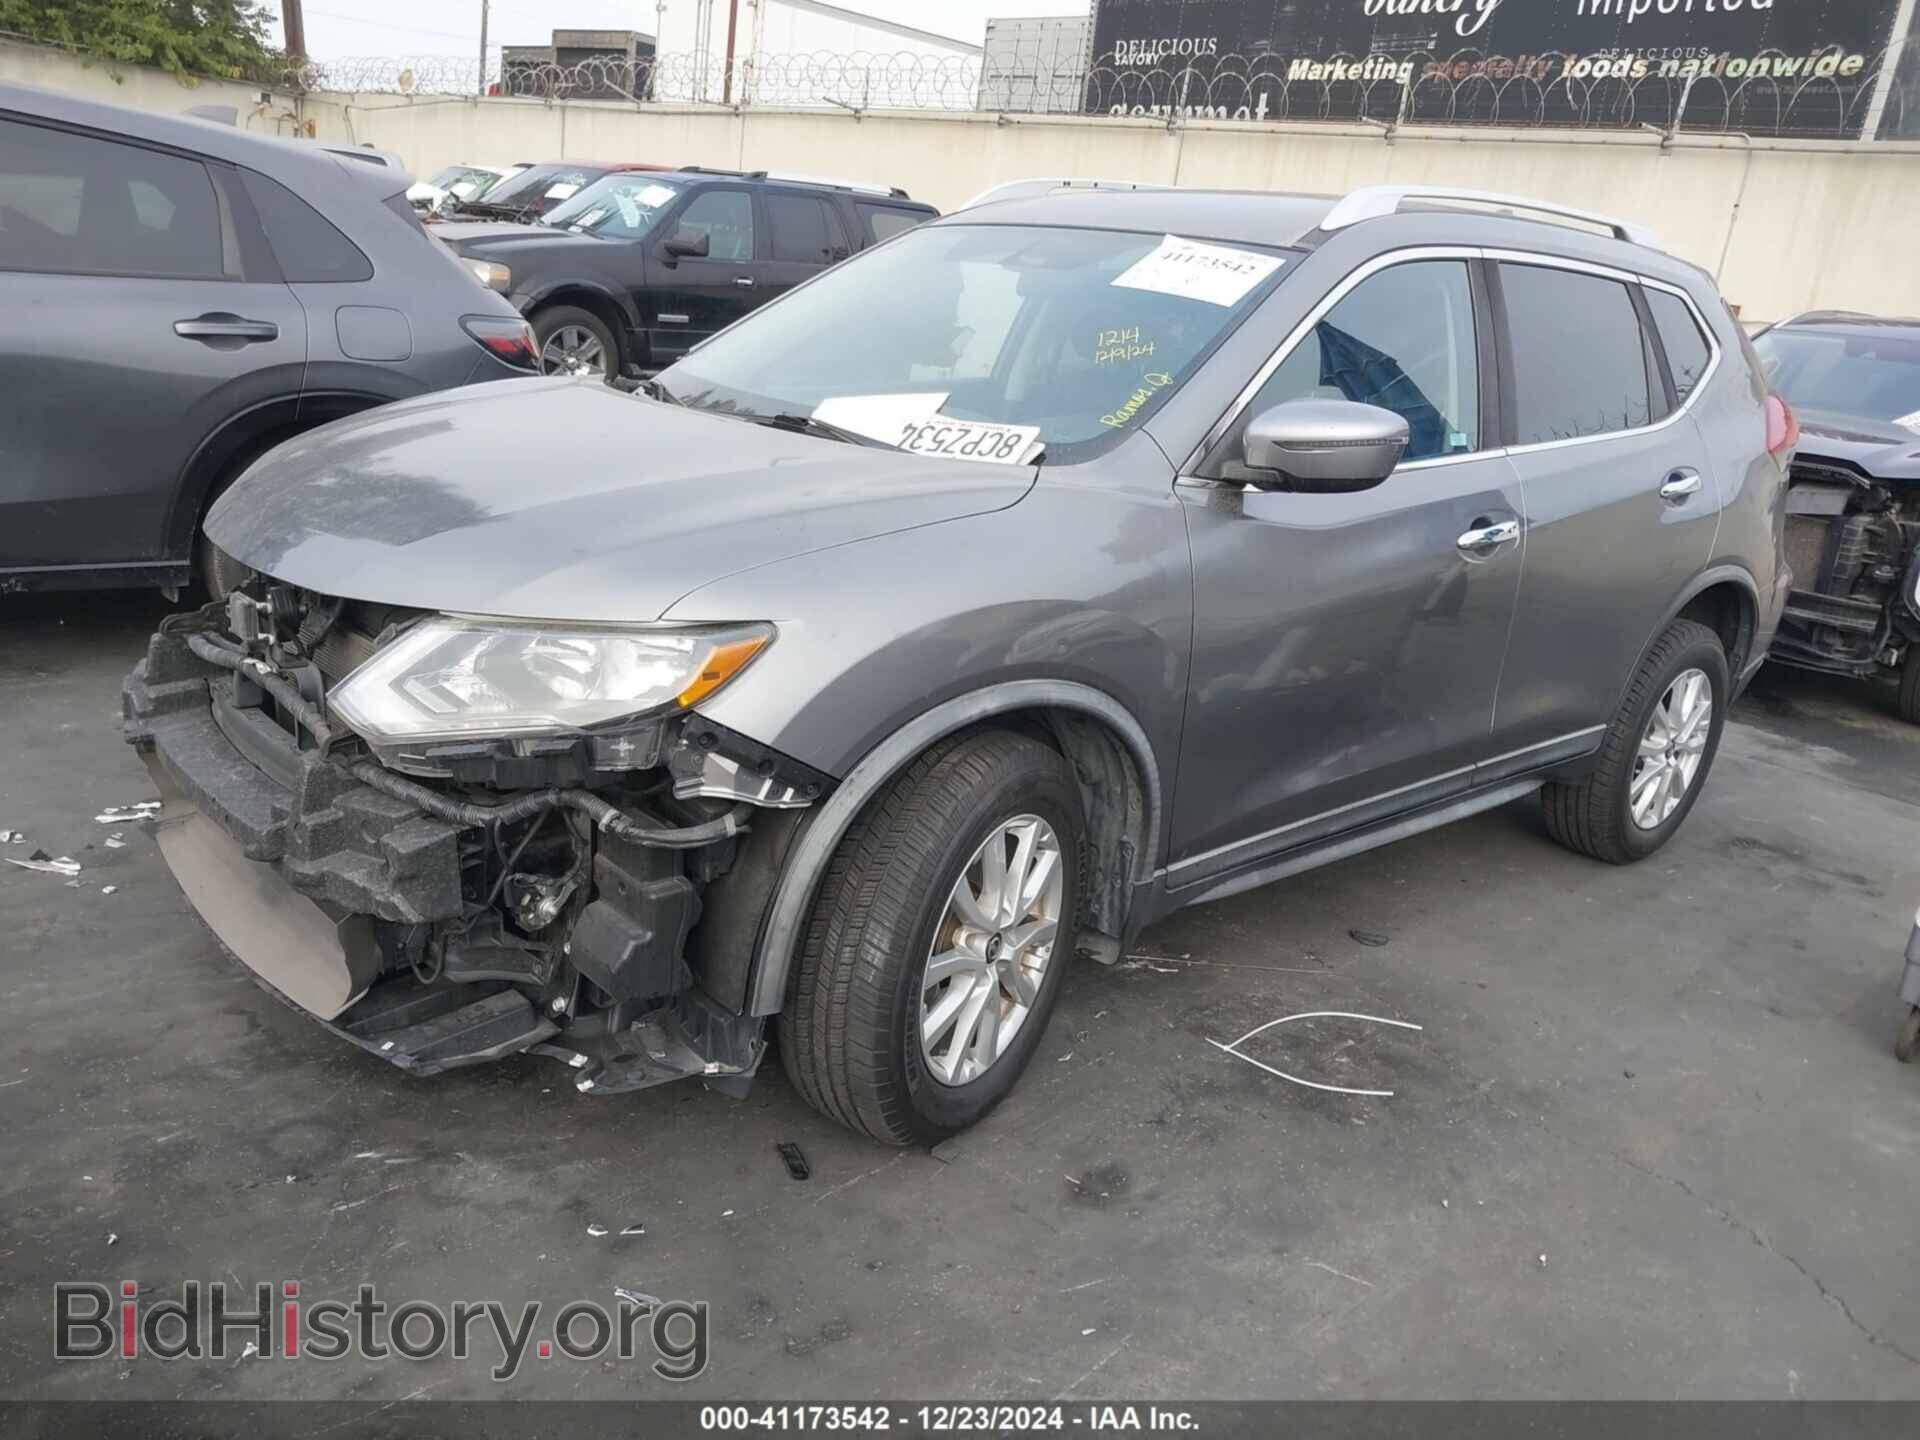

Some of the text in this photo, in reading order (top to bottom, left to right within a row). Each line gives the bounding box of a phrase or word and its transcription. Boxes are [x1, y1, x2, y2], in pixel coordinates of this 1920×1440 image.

[1114, 38, 1217, 56] DELICIOUS
[1600, 47, 1709, 60] DELICIOUS
[1114, 53, 1160, 66] SAVORY
[1288, 57, 1414, 84] Marketing
[1561, 53, 1649, 78] foods
[1658, 49, 1864, 79] nationwide
[897, 422, 1022, 458] 8CPZ534
